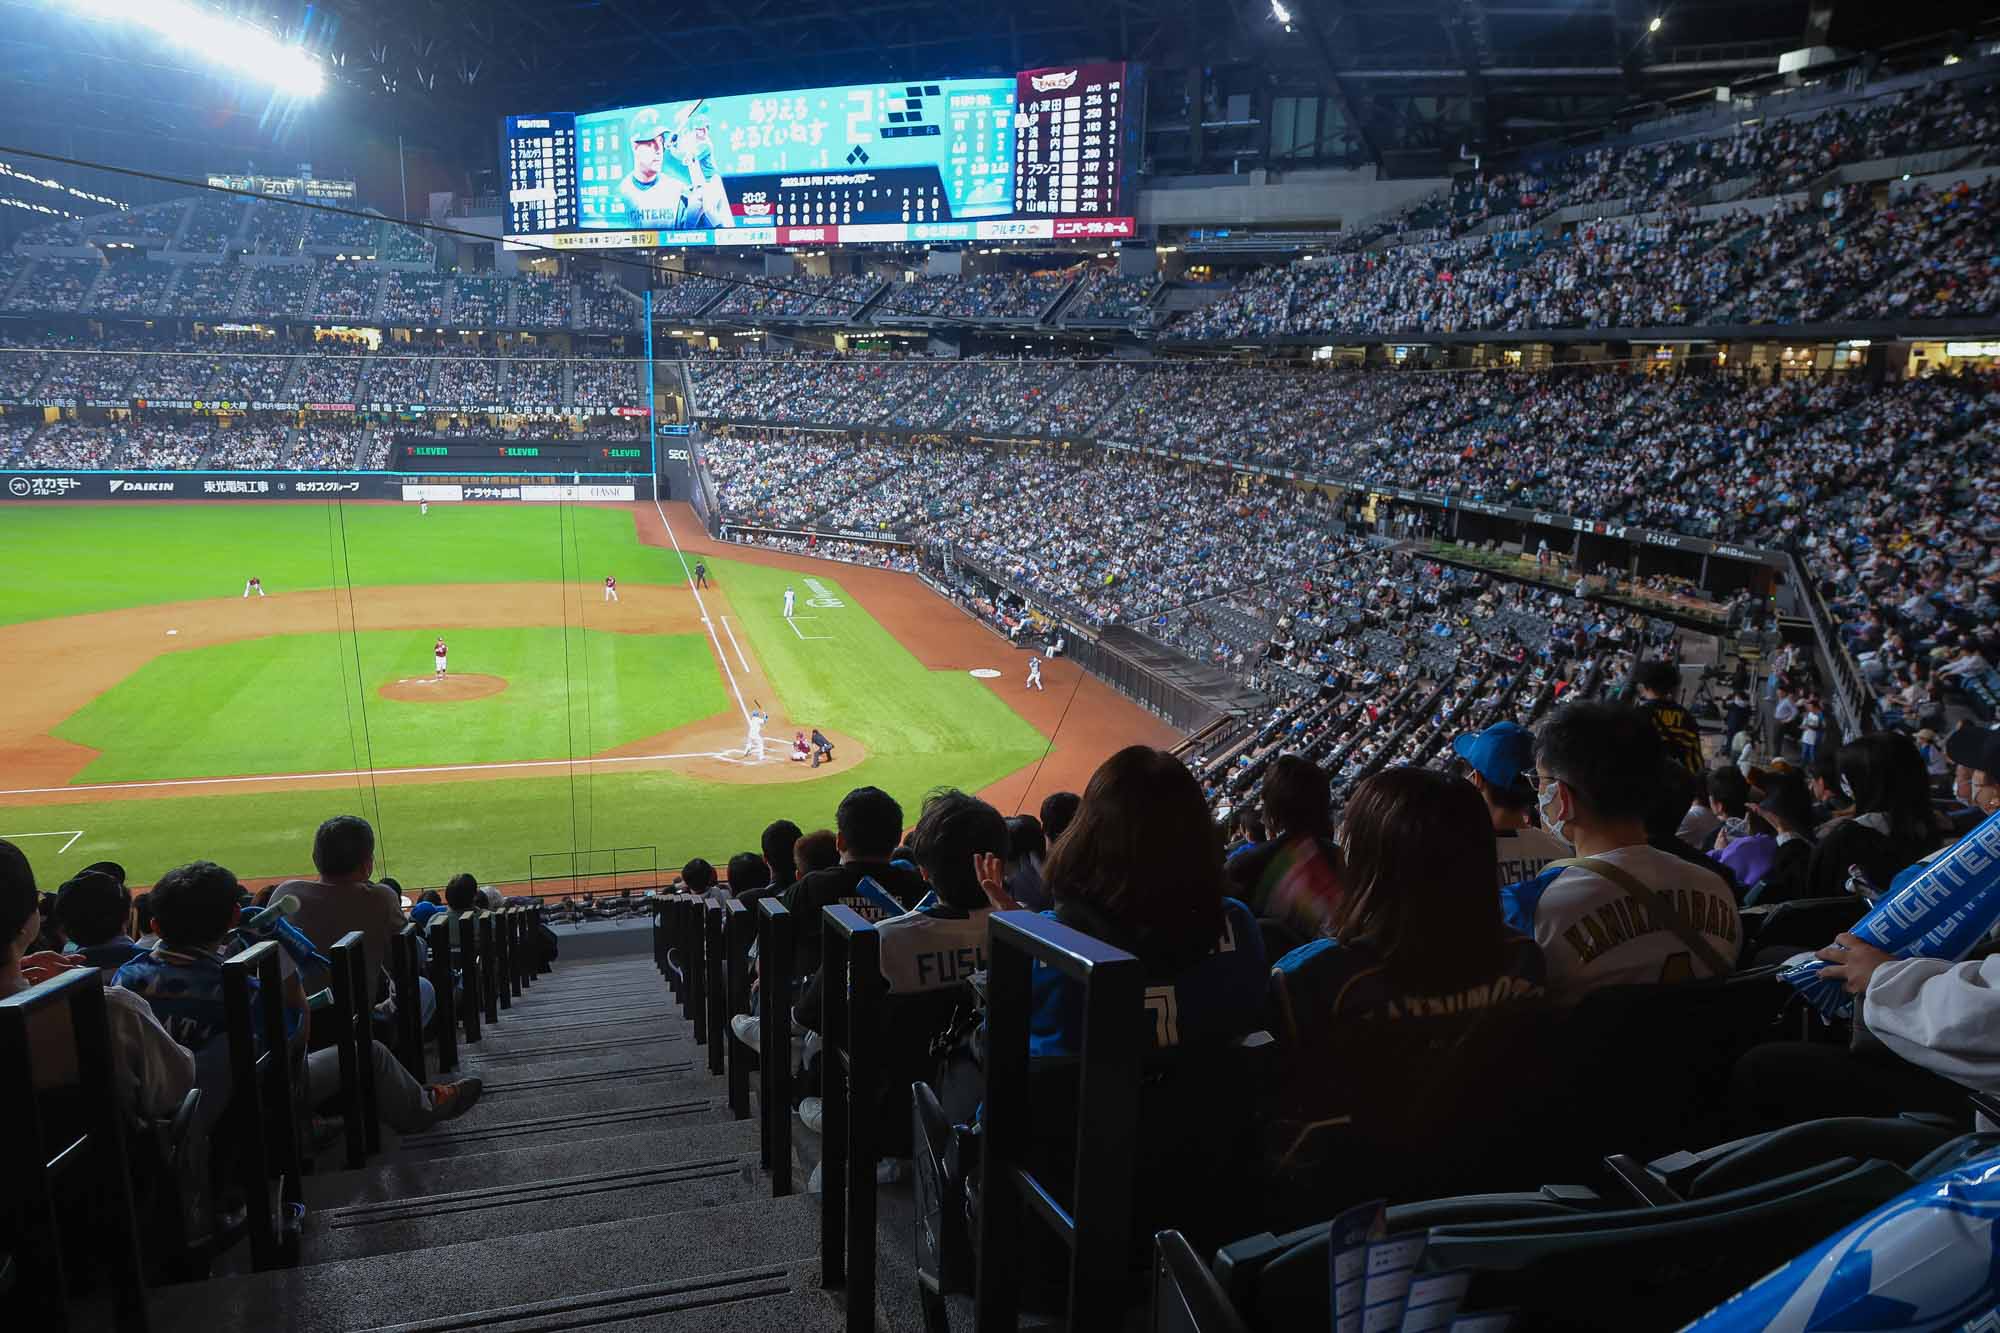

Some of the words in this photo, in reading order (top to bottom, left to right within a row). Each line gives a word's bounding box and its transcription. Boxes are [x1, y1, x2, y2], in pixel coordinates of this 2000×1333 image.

[1110, 92, 1118, 103] 0
[846, 90, 873, 144] 2
[1111, 106, 1116, 117] 1
[1109, 120, 1116, 131] 3
[1109, 134, 1116, 145] 2
[1110, 147, 1114, 158] 1
[1028, 164, 1060, 175] フランコ
[1107, 161, 1114, 172] 3
[1108, 175, 1113, 185] 1
[263, 181, 296, 195] FAV
[791, 193, 795, 201] 2
[804, 192, 809, 200] 3
[817, 191, 822, 200] 4
[831, 191, 836, 199] 5
[844, 190, 849, 199] 6
[858, 190, 864, 199] 7
[872, 189, 878, 198] 8
[886, 188, 892, 197] 9
[903, 188, 909, 197] R
[918, 187, 924, 196] H
[932, 186, 938, 195] E
[1107, 188, 1112, 199] 1
[742, 192, 767, 204] 20:02
[777, 203, 784, 215] 0
[790, 203, 797, 214] 0
[803, 203, 810, 214] 0
[816, 202, 823, 213] 0
[829, 202, 837, 213] 0
[843, 201, 850, 212] 2
[857, 201, 864, 212] 0
[902, 199, 909, 210] 2
[931, 198, 939, 209] 0
[1107, 202, 1112, 212] 1
[777, 215, 784, 226] 0
[790, 215, 797, 226] 0
[803, 214, 810, 225] 0
[816, 213, 823, 225] 0
[829, 213, 837, 225] 0
[843, 212, 850, 224] 0
[902, 211, 910, 222] 0
[932, 210, 938, 220] 1
[31, 478, 81, 489] オカモト
[123, 482, 174, 492] DAIKIN
[295, 481, 360, 492] 北ガスグループ
[33, 488, 65, 496] グループ
[1645, 533, 1681, 546] そらとしば
[1868, 818, 2000, 944] FIGHTER
